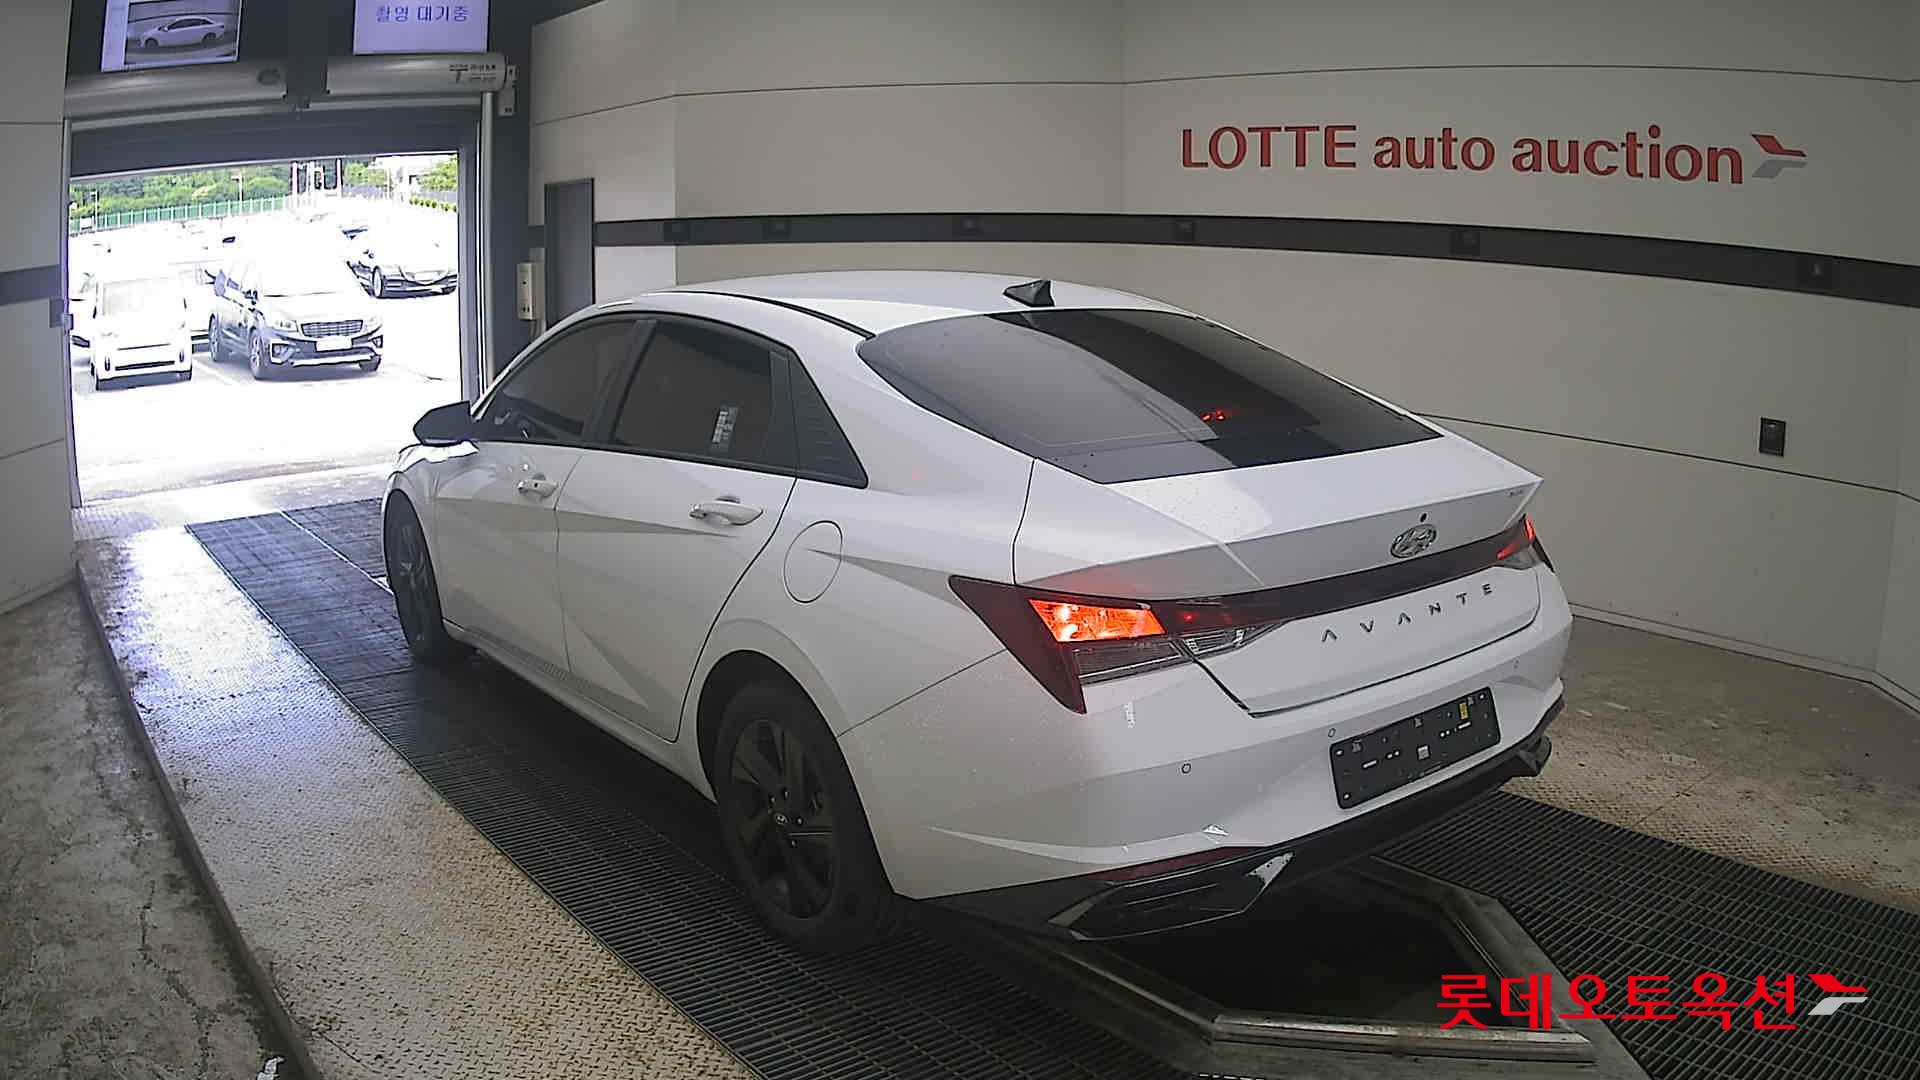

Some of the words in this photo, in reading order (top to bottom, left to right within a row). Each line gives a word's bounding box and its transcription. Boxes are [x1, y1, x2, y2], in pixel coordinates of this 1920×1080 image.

[417, 4, 470, 22] 대기중
[1181, 125, 1357, 169] LOTTE
[1373, 127, 1496, 170] auto
[1512, 125, 1743, 184] auction
[1321, 583, 1493, 642] AVANTE
